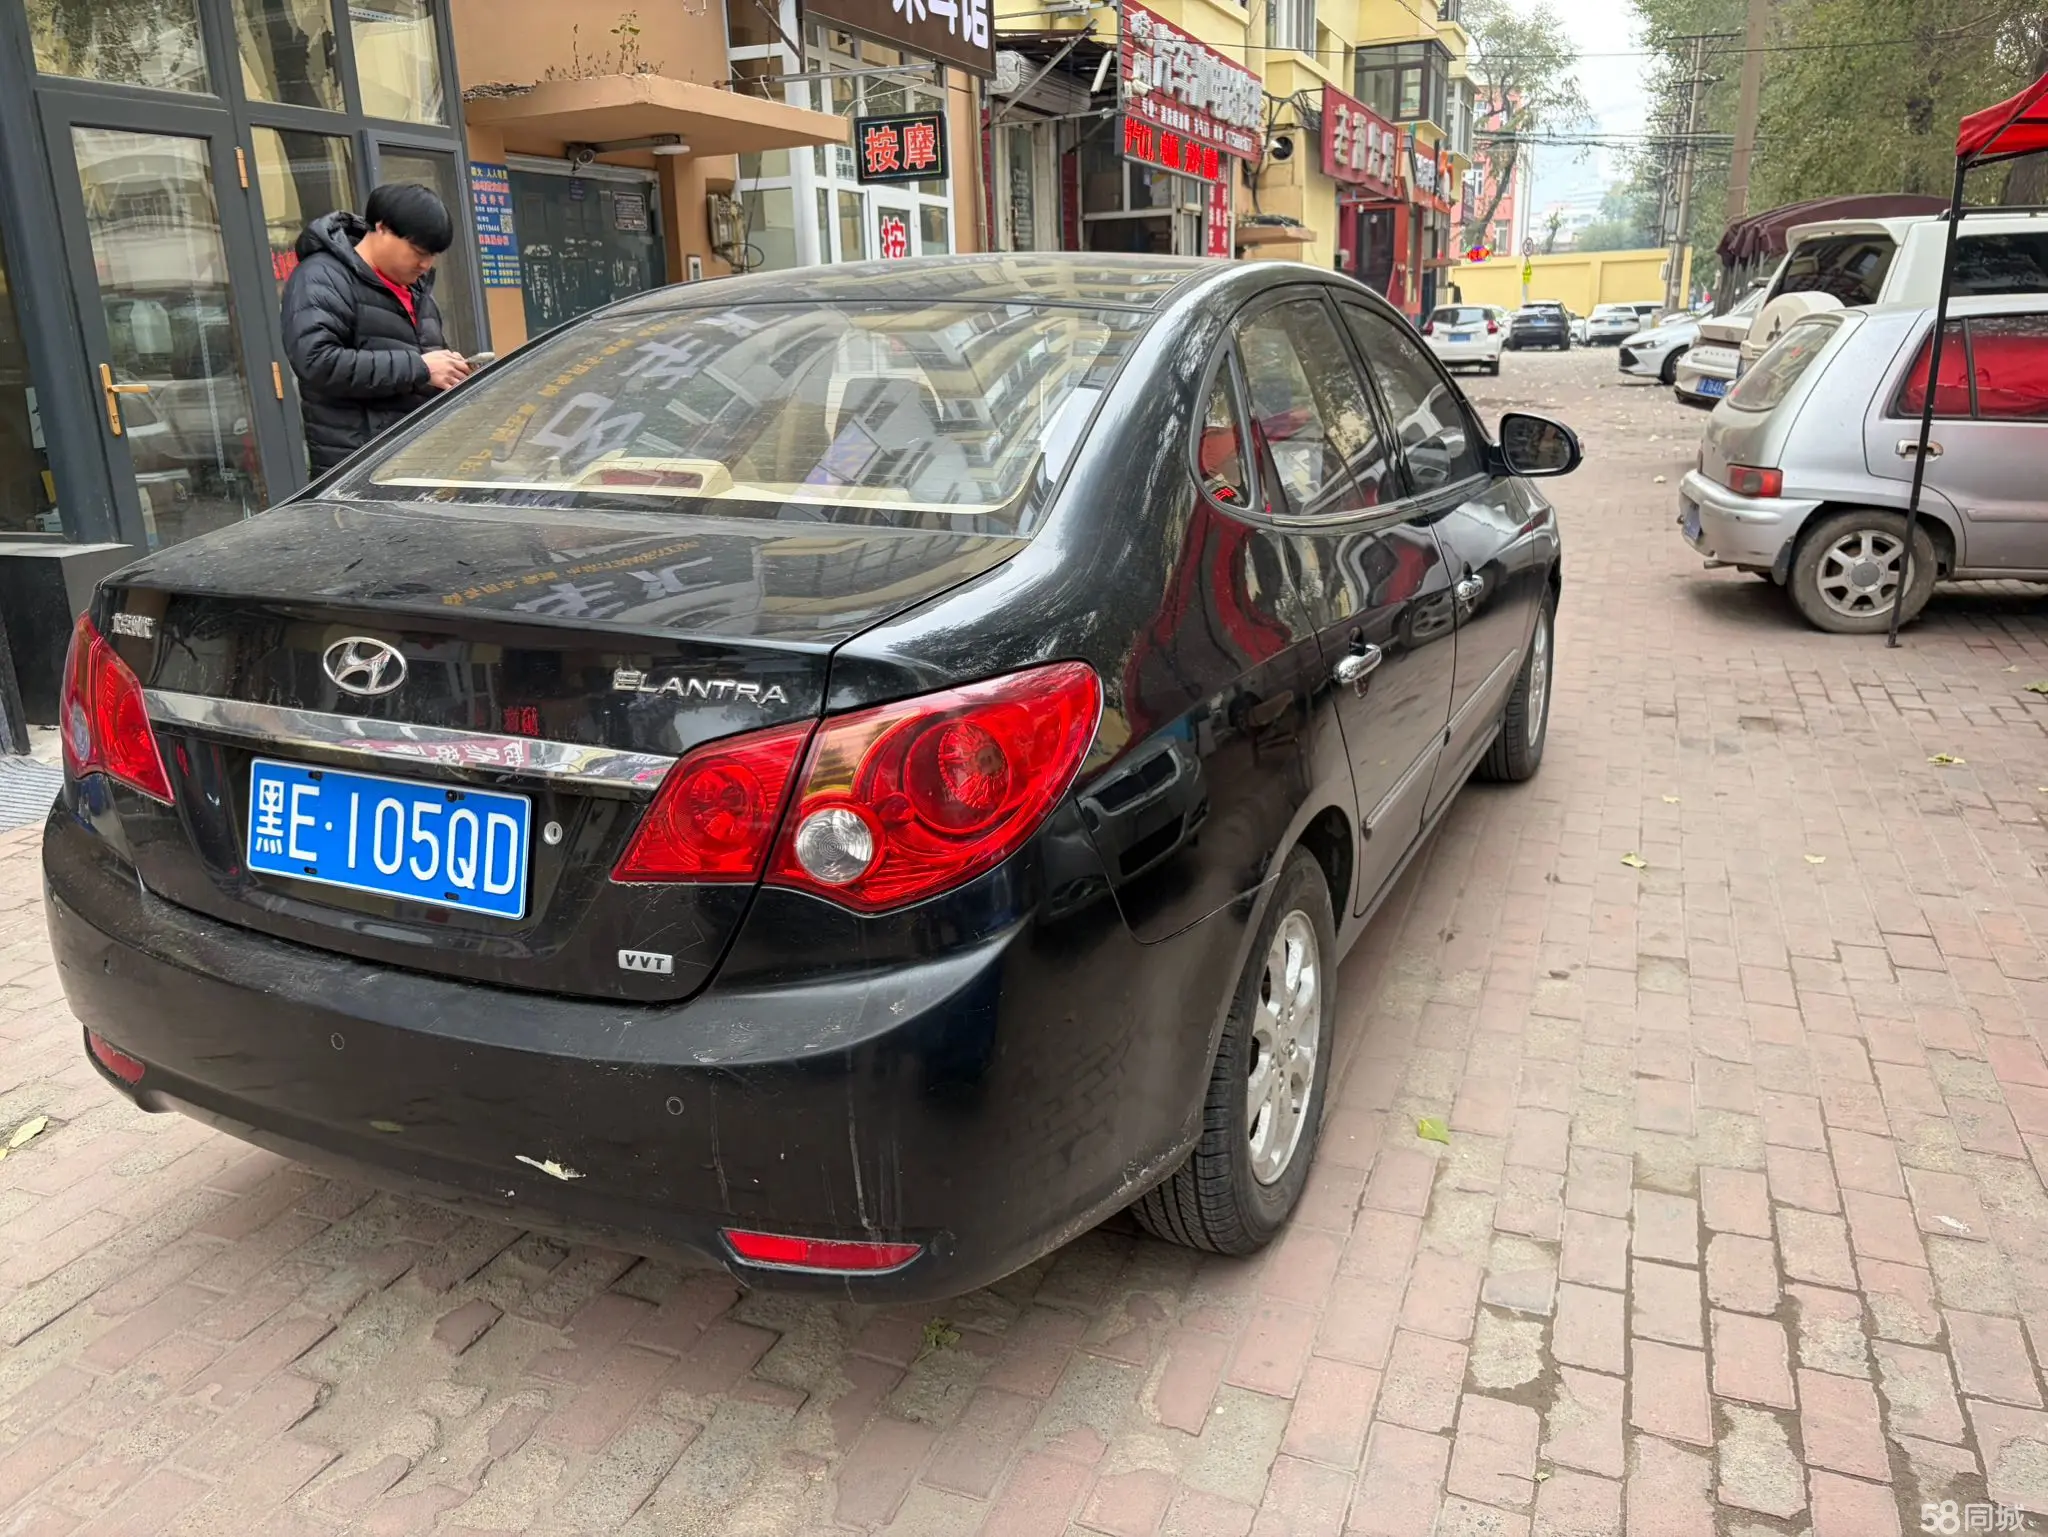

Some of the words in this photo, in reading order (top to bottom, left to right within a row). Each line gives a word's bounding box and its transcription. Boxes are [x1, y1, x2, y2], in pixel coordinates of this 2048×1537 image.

[865, 122, 937, 173] 按摩
[612, 668, 789, 705] ELANTRA
[255, 778, 519, 896] 黑E·105QD
[625, 953, 666, 970] VVT
